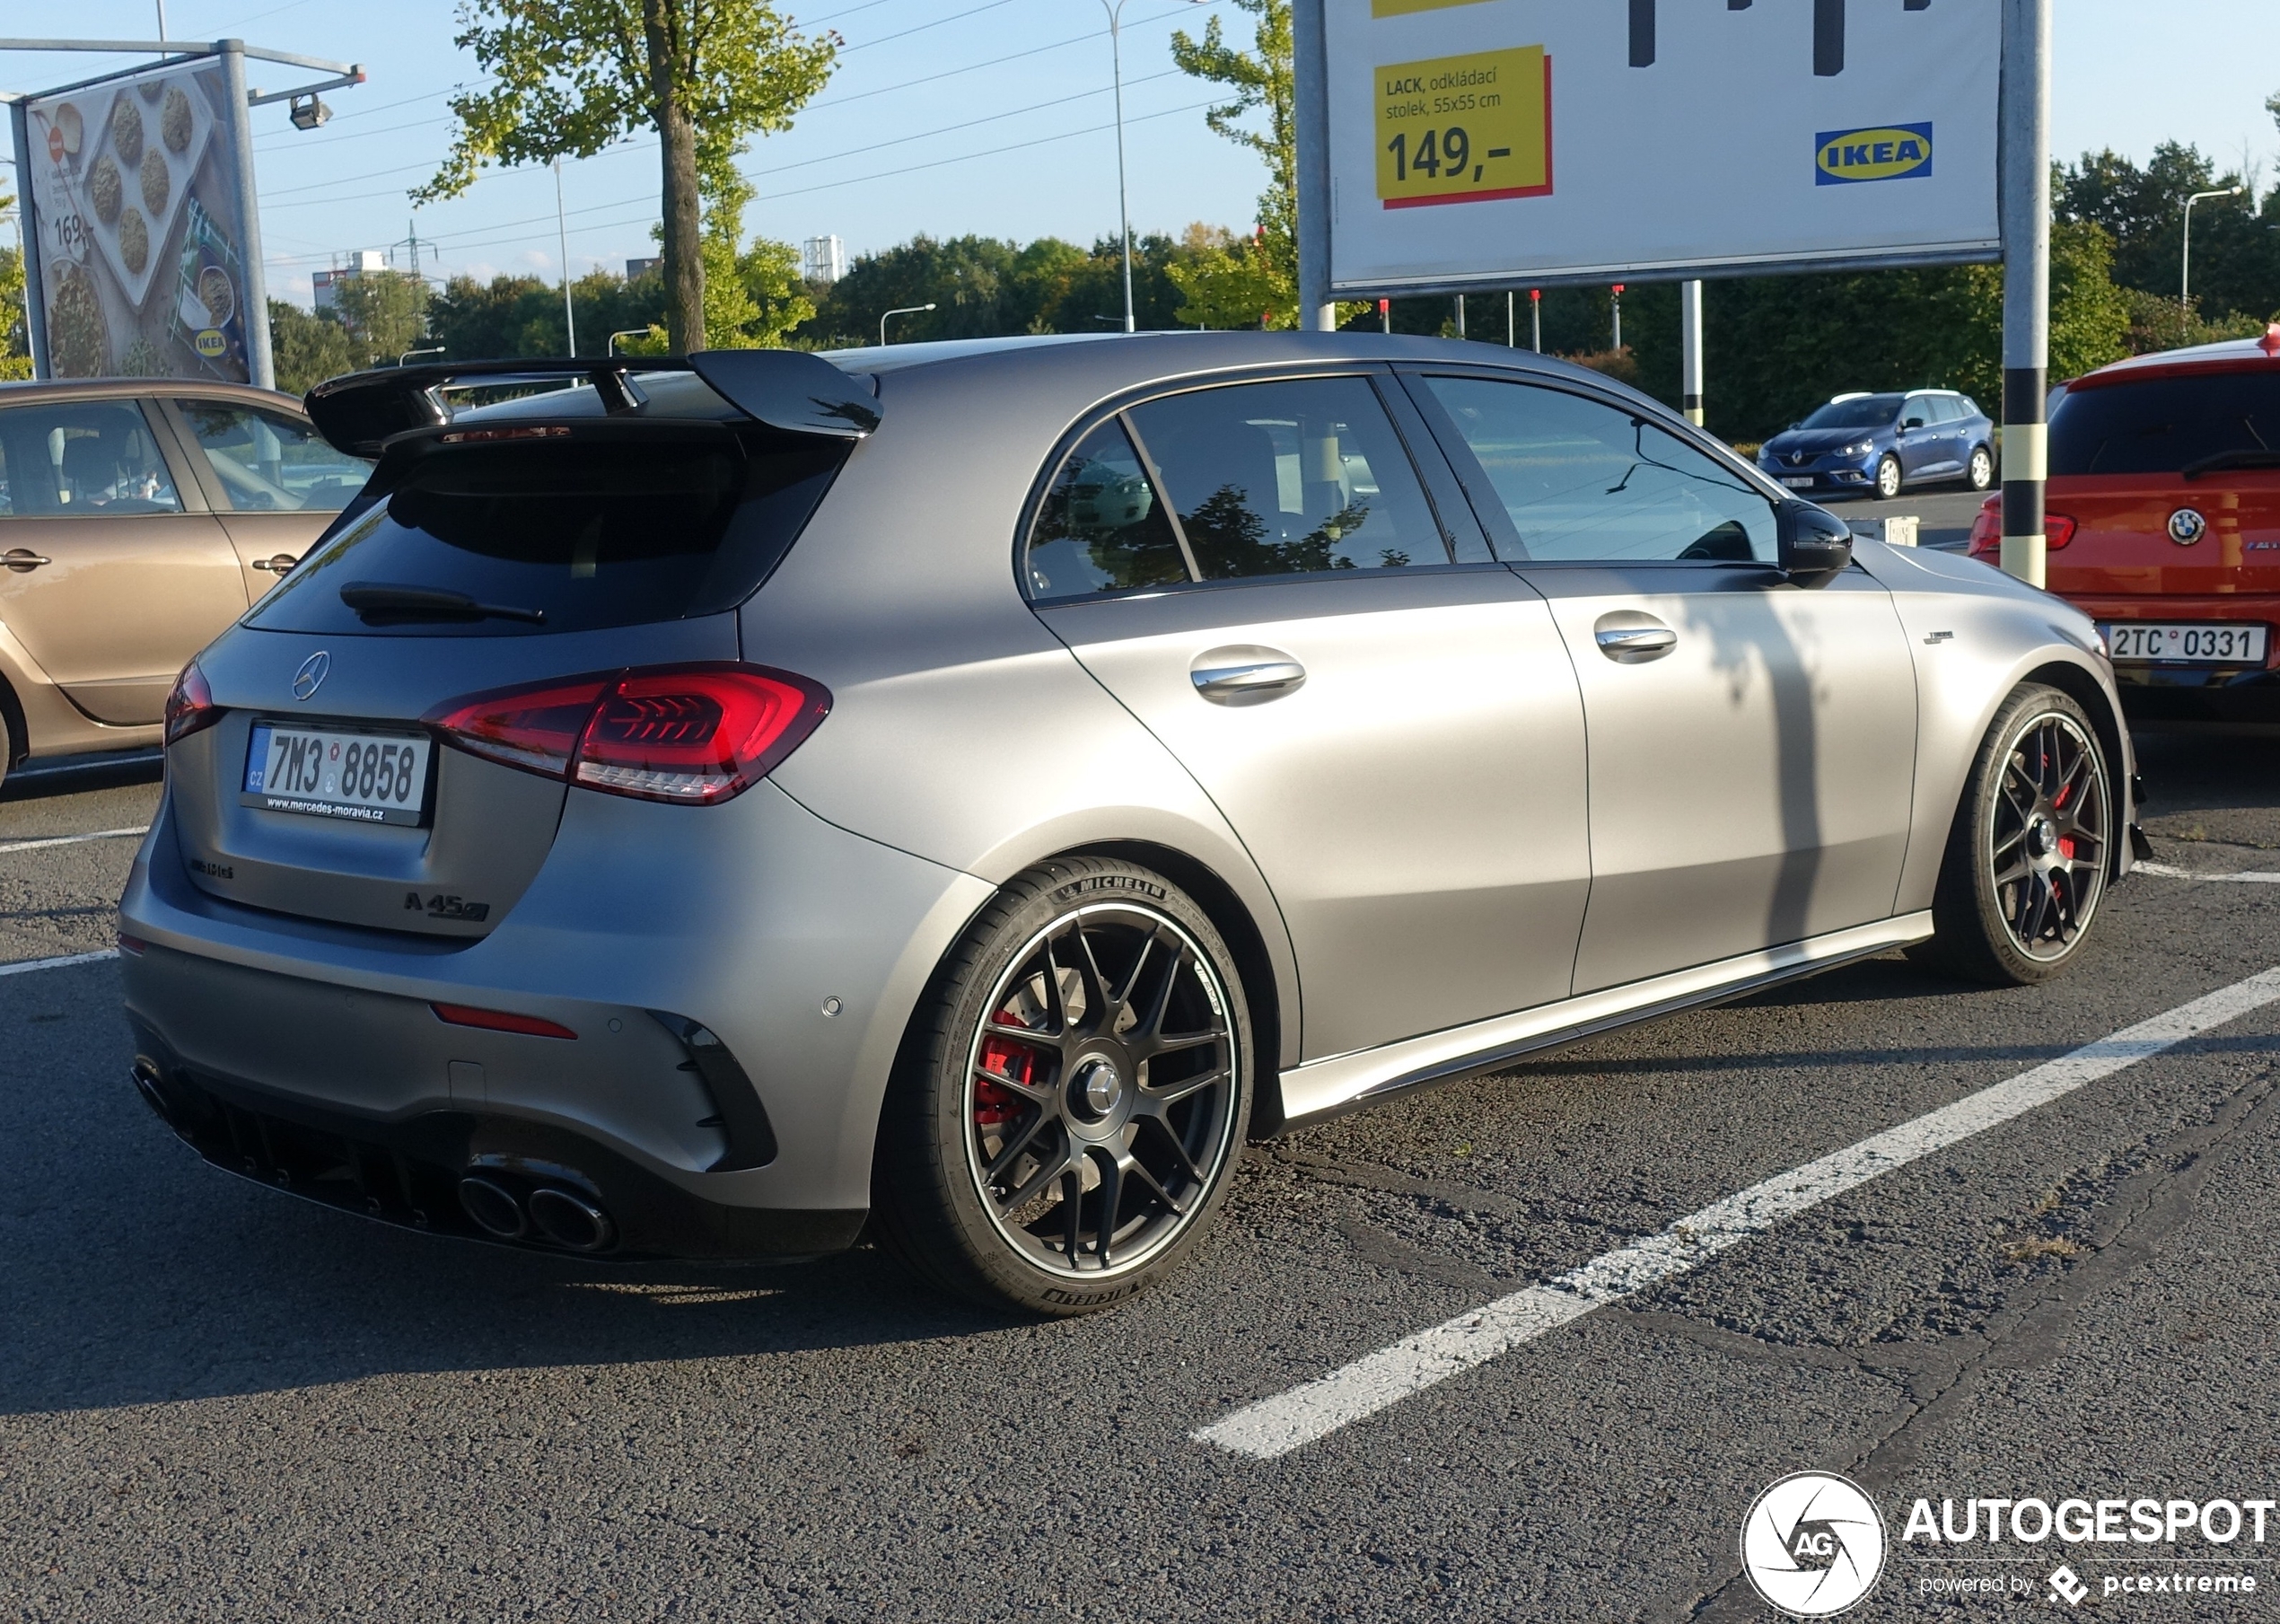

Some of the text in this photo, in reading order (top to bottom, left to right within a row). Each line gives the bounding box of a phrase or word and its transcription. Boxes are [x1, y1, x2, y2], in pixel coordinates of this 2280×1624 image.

[1386, 66, 1497, 96] LACK, odkládací
[1386, 93, 1500, 119] stolek, 55x55 cm
[1828, 140, 1922, 168] IKEA
[198, 337, 224, 349] IKEA
[2114, 629, 2250, 658] 2TC 0331
[250, 770, 263, 786] CZ
[269, 735, 415, 803] 7M3 8858
[267, 797, 384, 821] www.mercedes-moravia.cz
[1081, 877, 1162, 897] MICHELIN
[404, 892, 423, 910] A
